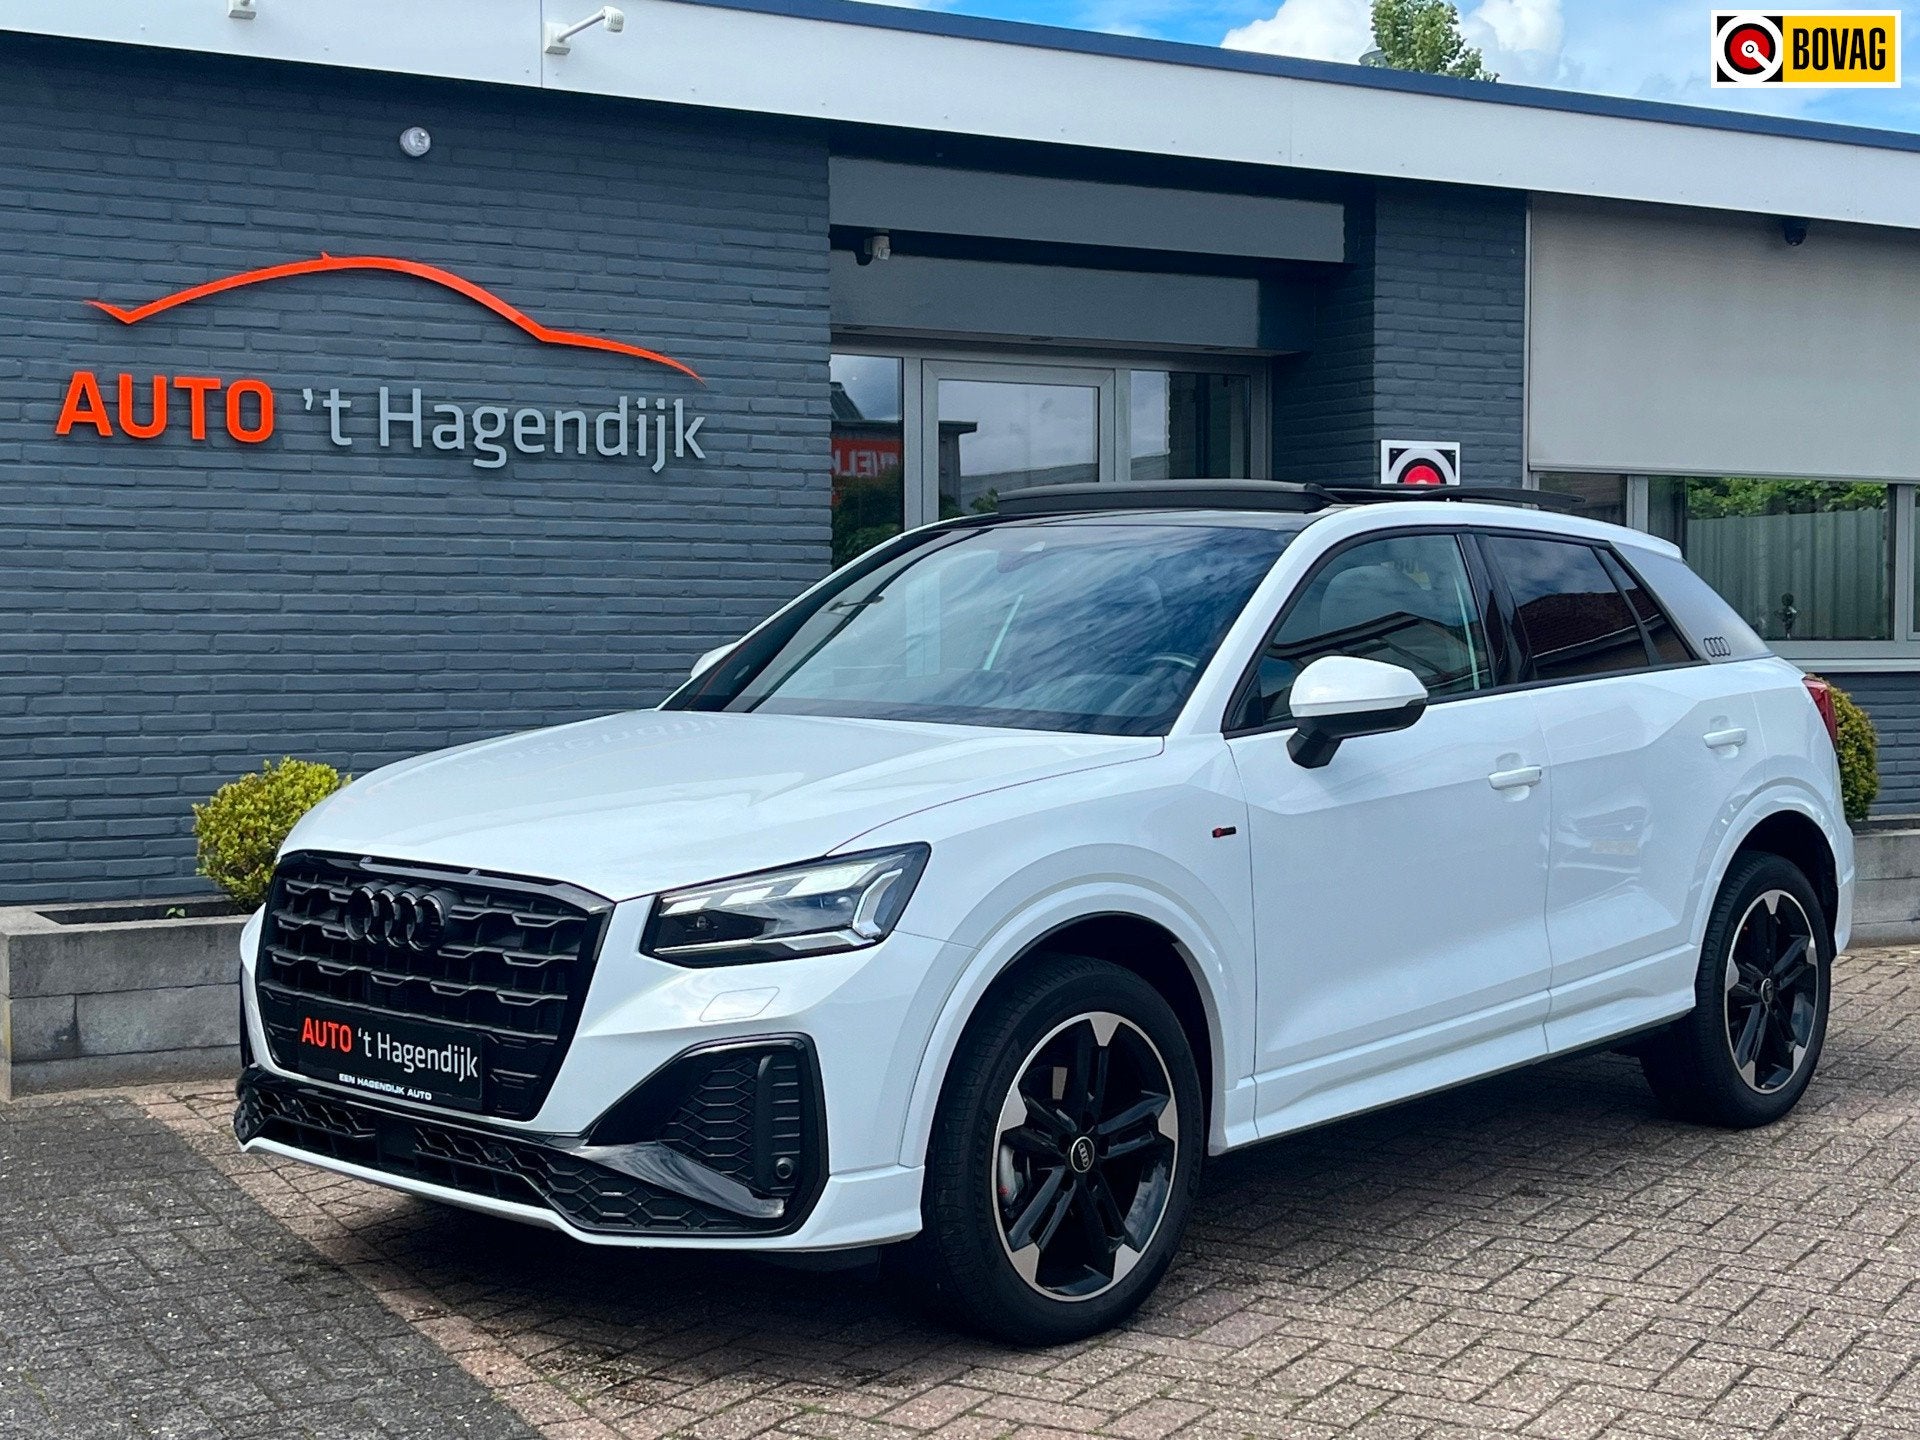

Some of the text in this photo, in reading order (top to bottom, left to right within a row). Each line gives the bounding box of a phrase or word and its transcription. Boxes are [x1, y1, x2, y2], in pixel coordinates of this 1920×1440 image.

[55, 371, 274, 443] AUTO
[379, 386, 706, 473] Hagendijk
[302, 1017, 352, 1053] AUTO
[377, 1031, 478, 1082] Hagendijk
[339, 1073, 432, 1101] EEN HAGENDIJK AUTO
